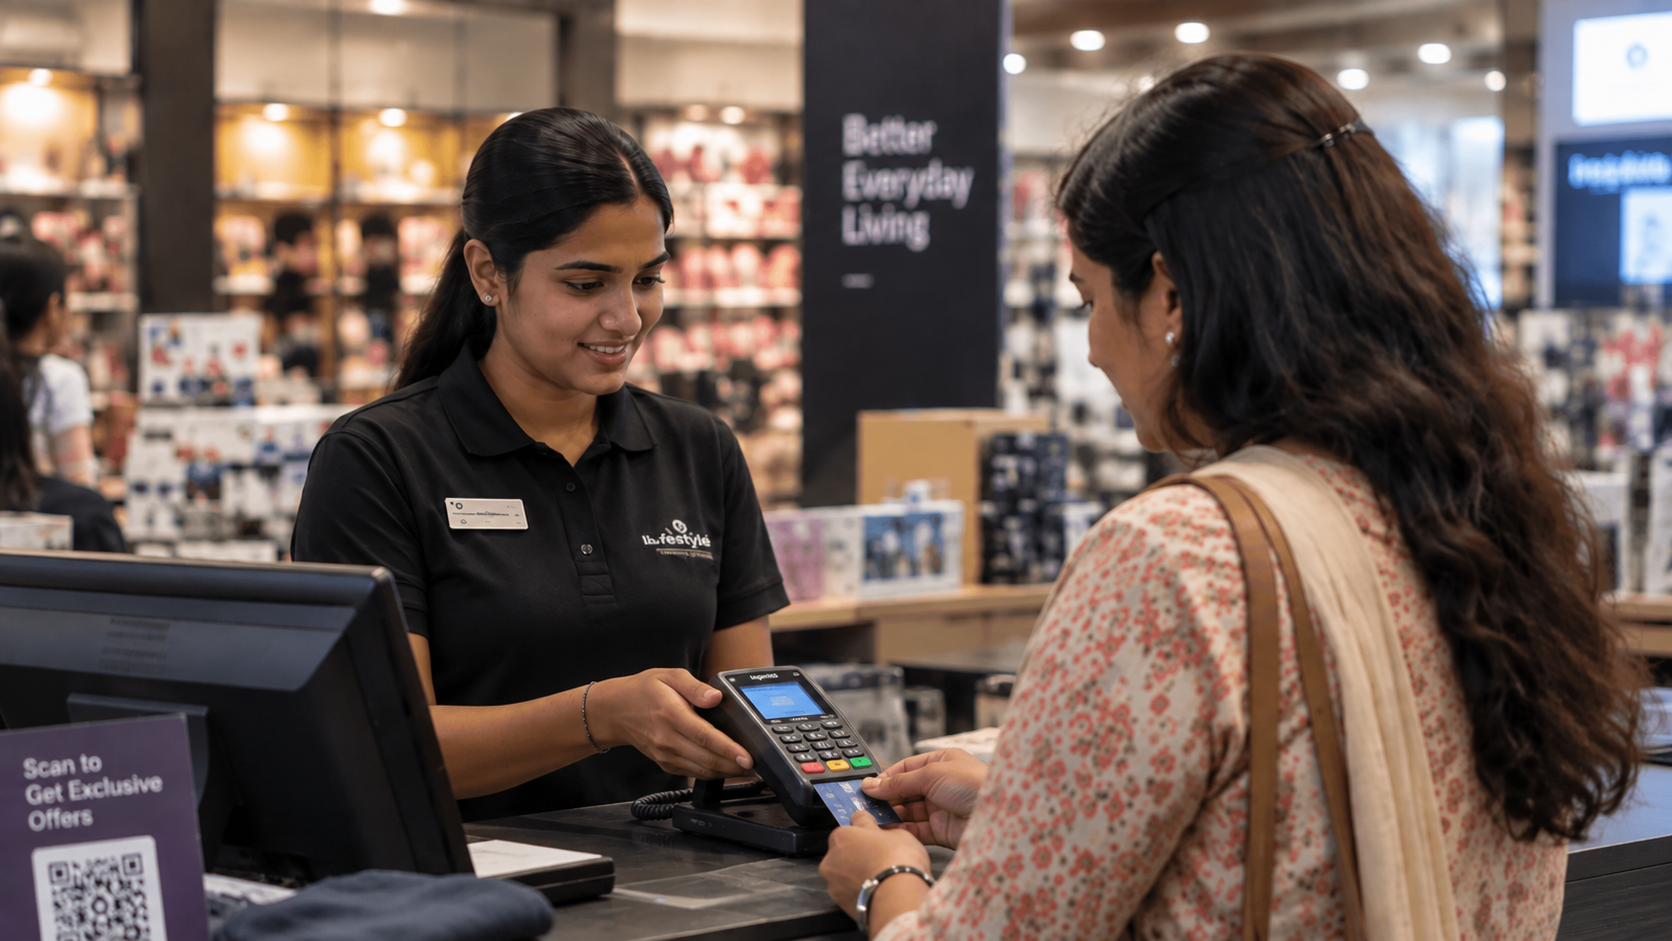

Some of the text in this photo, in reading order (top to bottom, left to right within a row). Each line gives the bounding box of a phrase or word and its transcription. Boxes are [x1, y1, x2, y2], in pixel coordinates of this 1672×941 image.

[842, 113, 938, 157] Better
[842, 158, 975, 209] Everyday
[842, 203, 930, 251] Living
[23, 753, 103, 780] Scan to
[25, 774, 163, 806] Get Exclusive
[28, 807, 94, 832] Offers
